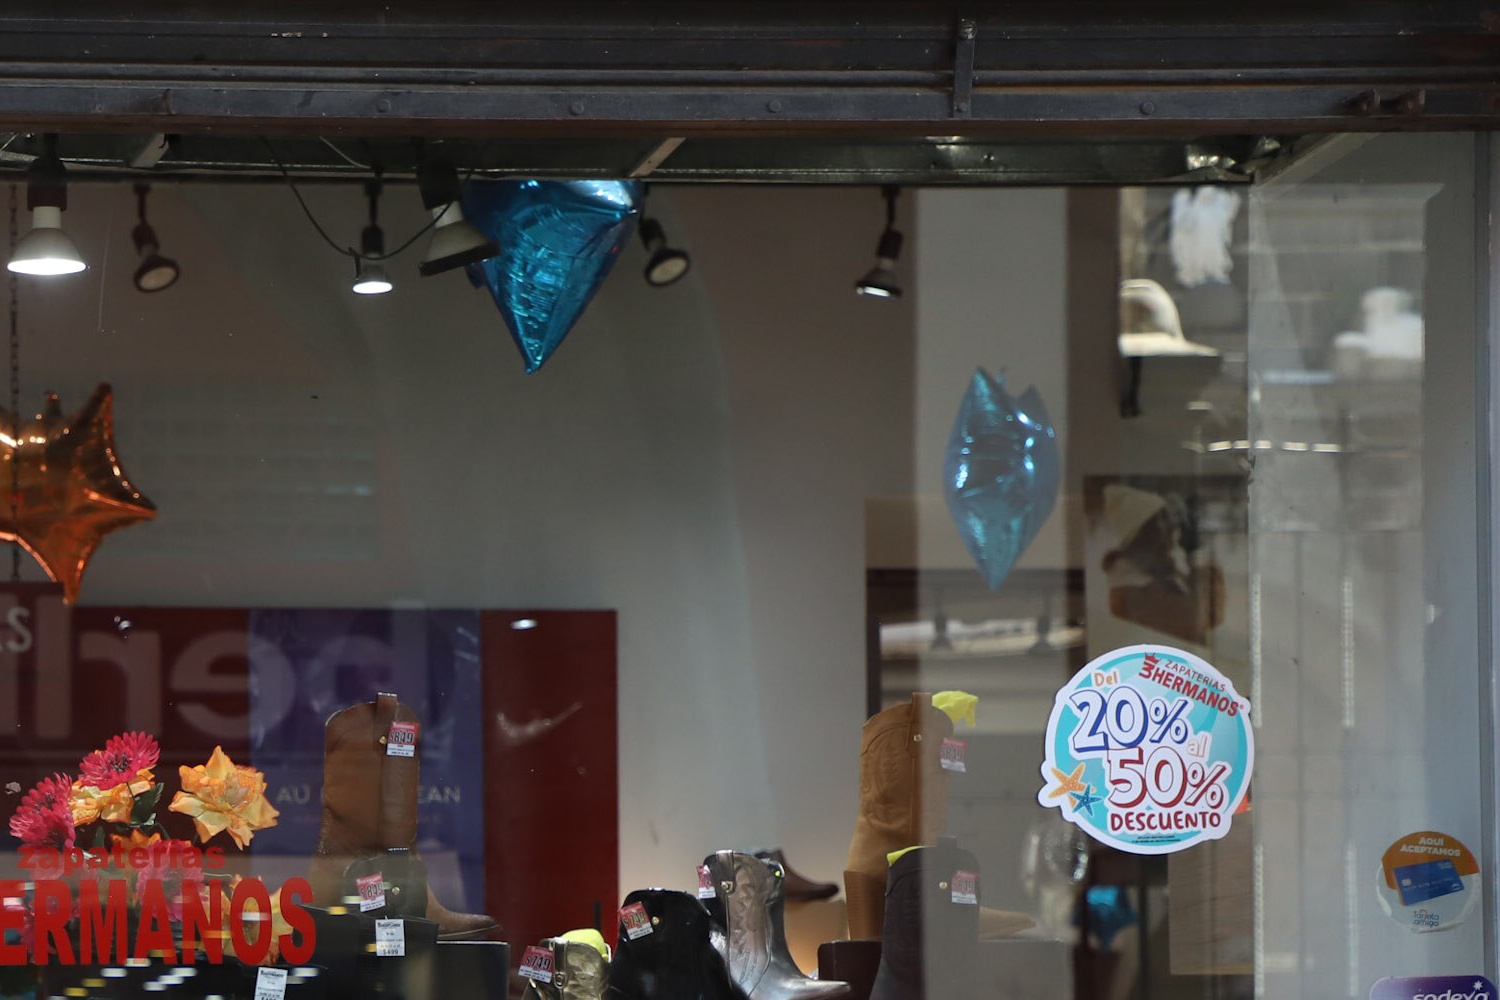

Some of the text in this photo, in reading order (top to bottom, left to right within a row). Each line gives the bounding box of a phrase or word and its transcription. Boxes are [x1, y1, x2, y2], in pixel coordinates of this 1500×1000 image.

[1093, 670, 1119, 688] Del
[1165, 659, 1226, 693] ZAPATERIAS
[1069, 685, 1189, 752] 20%
[1187, 734, 1208, 758] al
[1107, 746, 1227, 810] 50%
[1110, 810, 1222, 831] DESCUENTO
[1399, 844, 1462, 858] ACEPTAMOS
